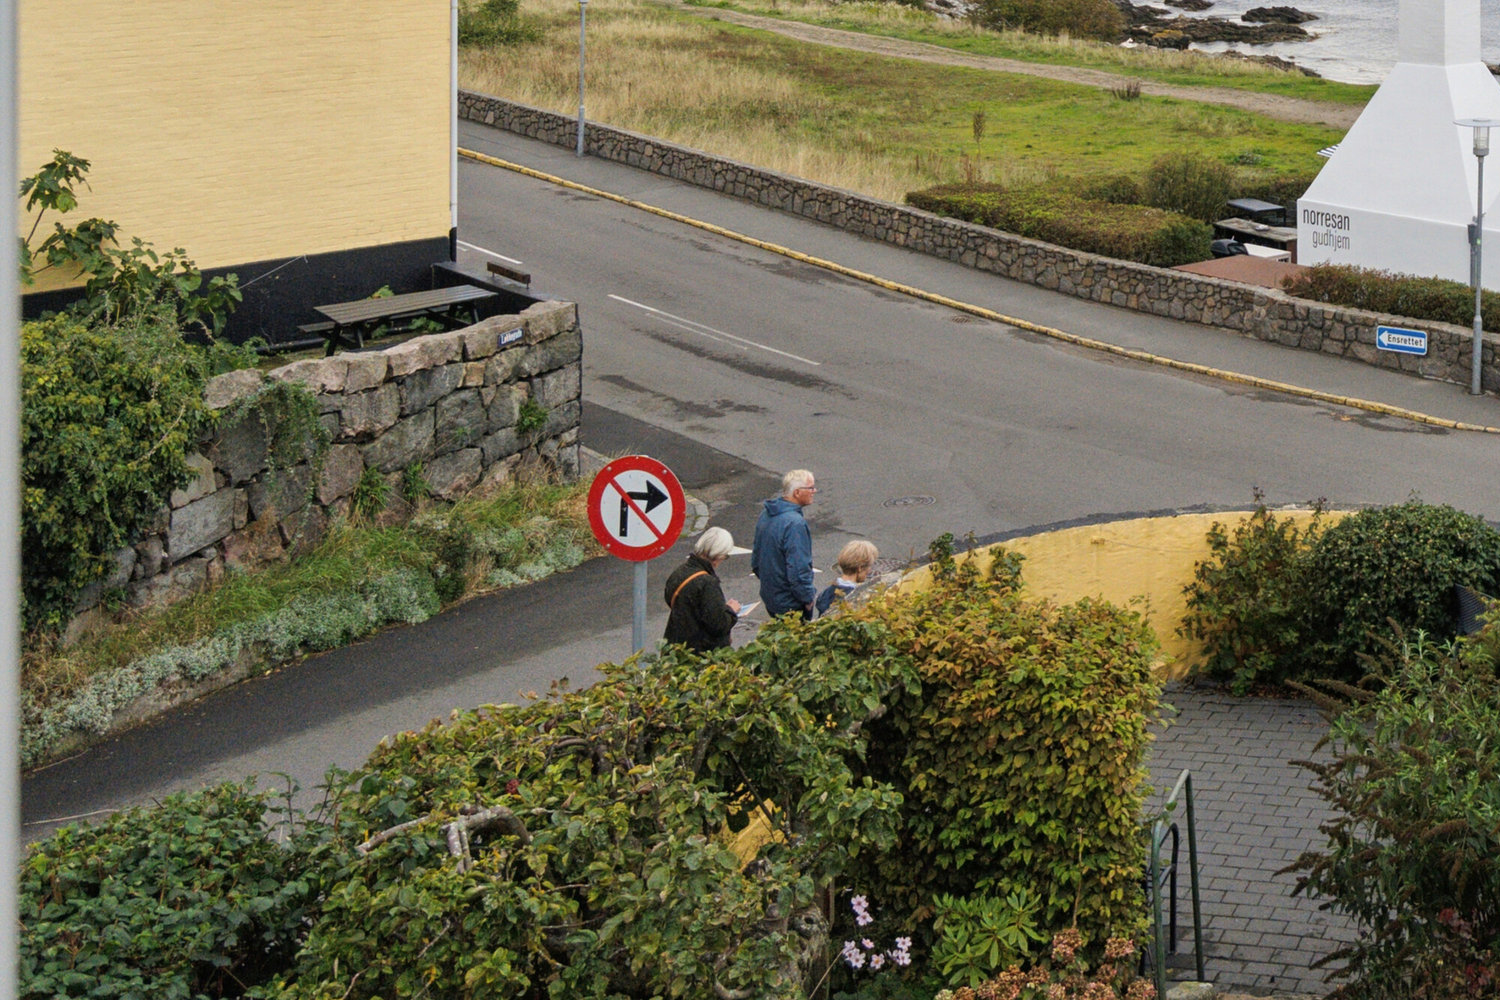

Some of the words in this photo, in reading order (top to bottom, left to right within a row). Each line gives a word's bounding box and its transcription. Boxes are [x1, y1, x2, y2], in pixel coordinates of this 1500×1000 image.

[1303, 209, 1350, 231] norresan
[1312, 229, 1350, 252] gudhjem
[1387, 334, 1423, 347] Ensrettet
